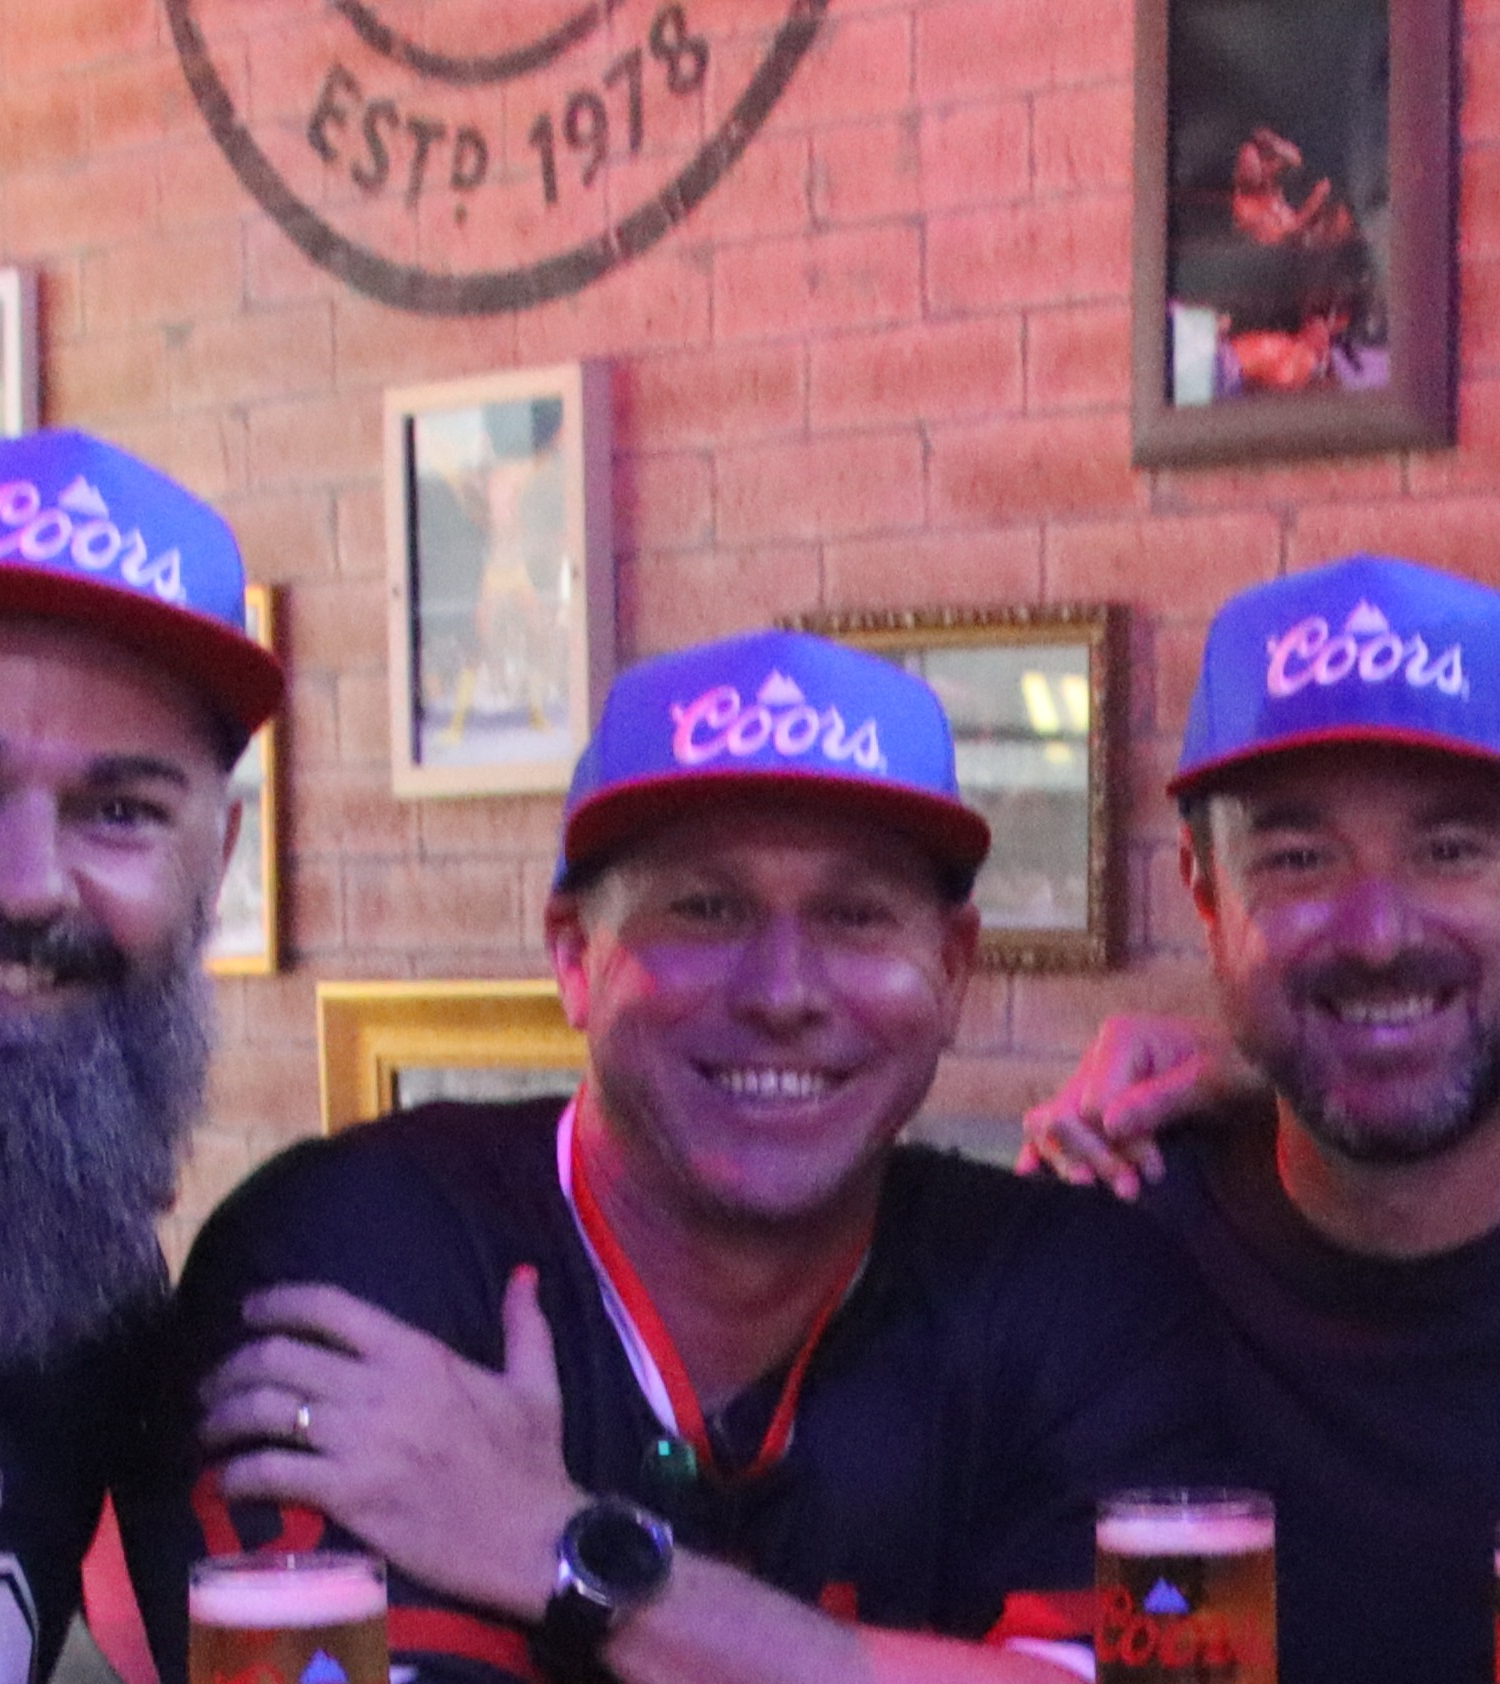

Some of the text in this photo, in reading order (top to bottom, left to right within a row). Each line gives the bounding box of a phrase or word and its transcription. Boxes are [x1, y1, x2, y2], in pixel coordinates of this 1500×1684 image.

[528, 3, 710, 207] 1978
[1266, 617, 1467, 700] Coors
[670, 685, 882, 770] Coors
